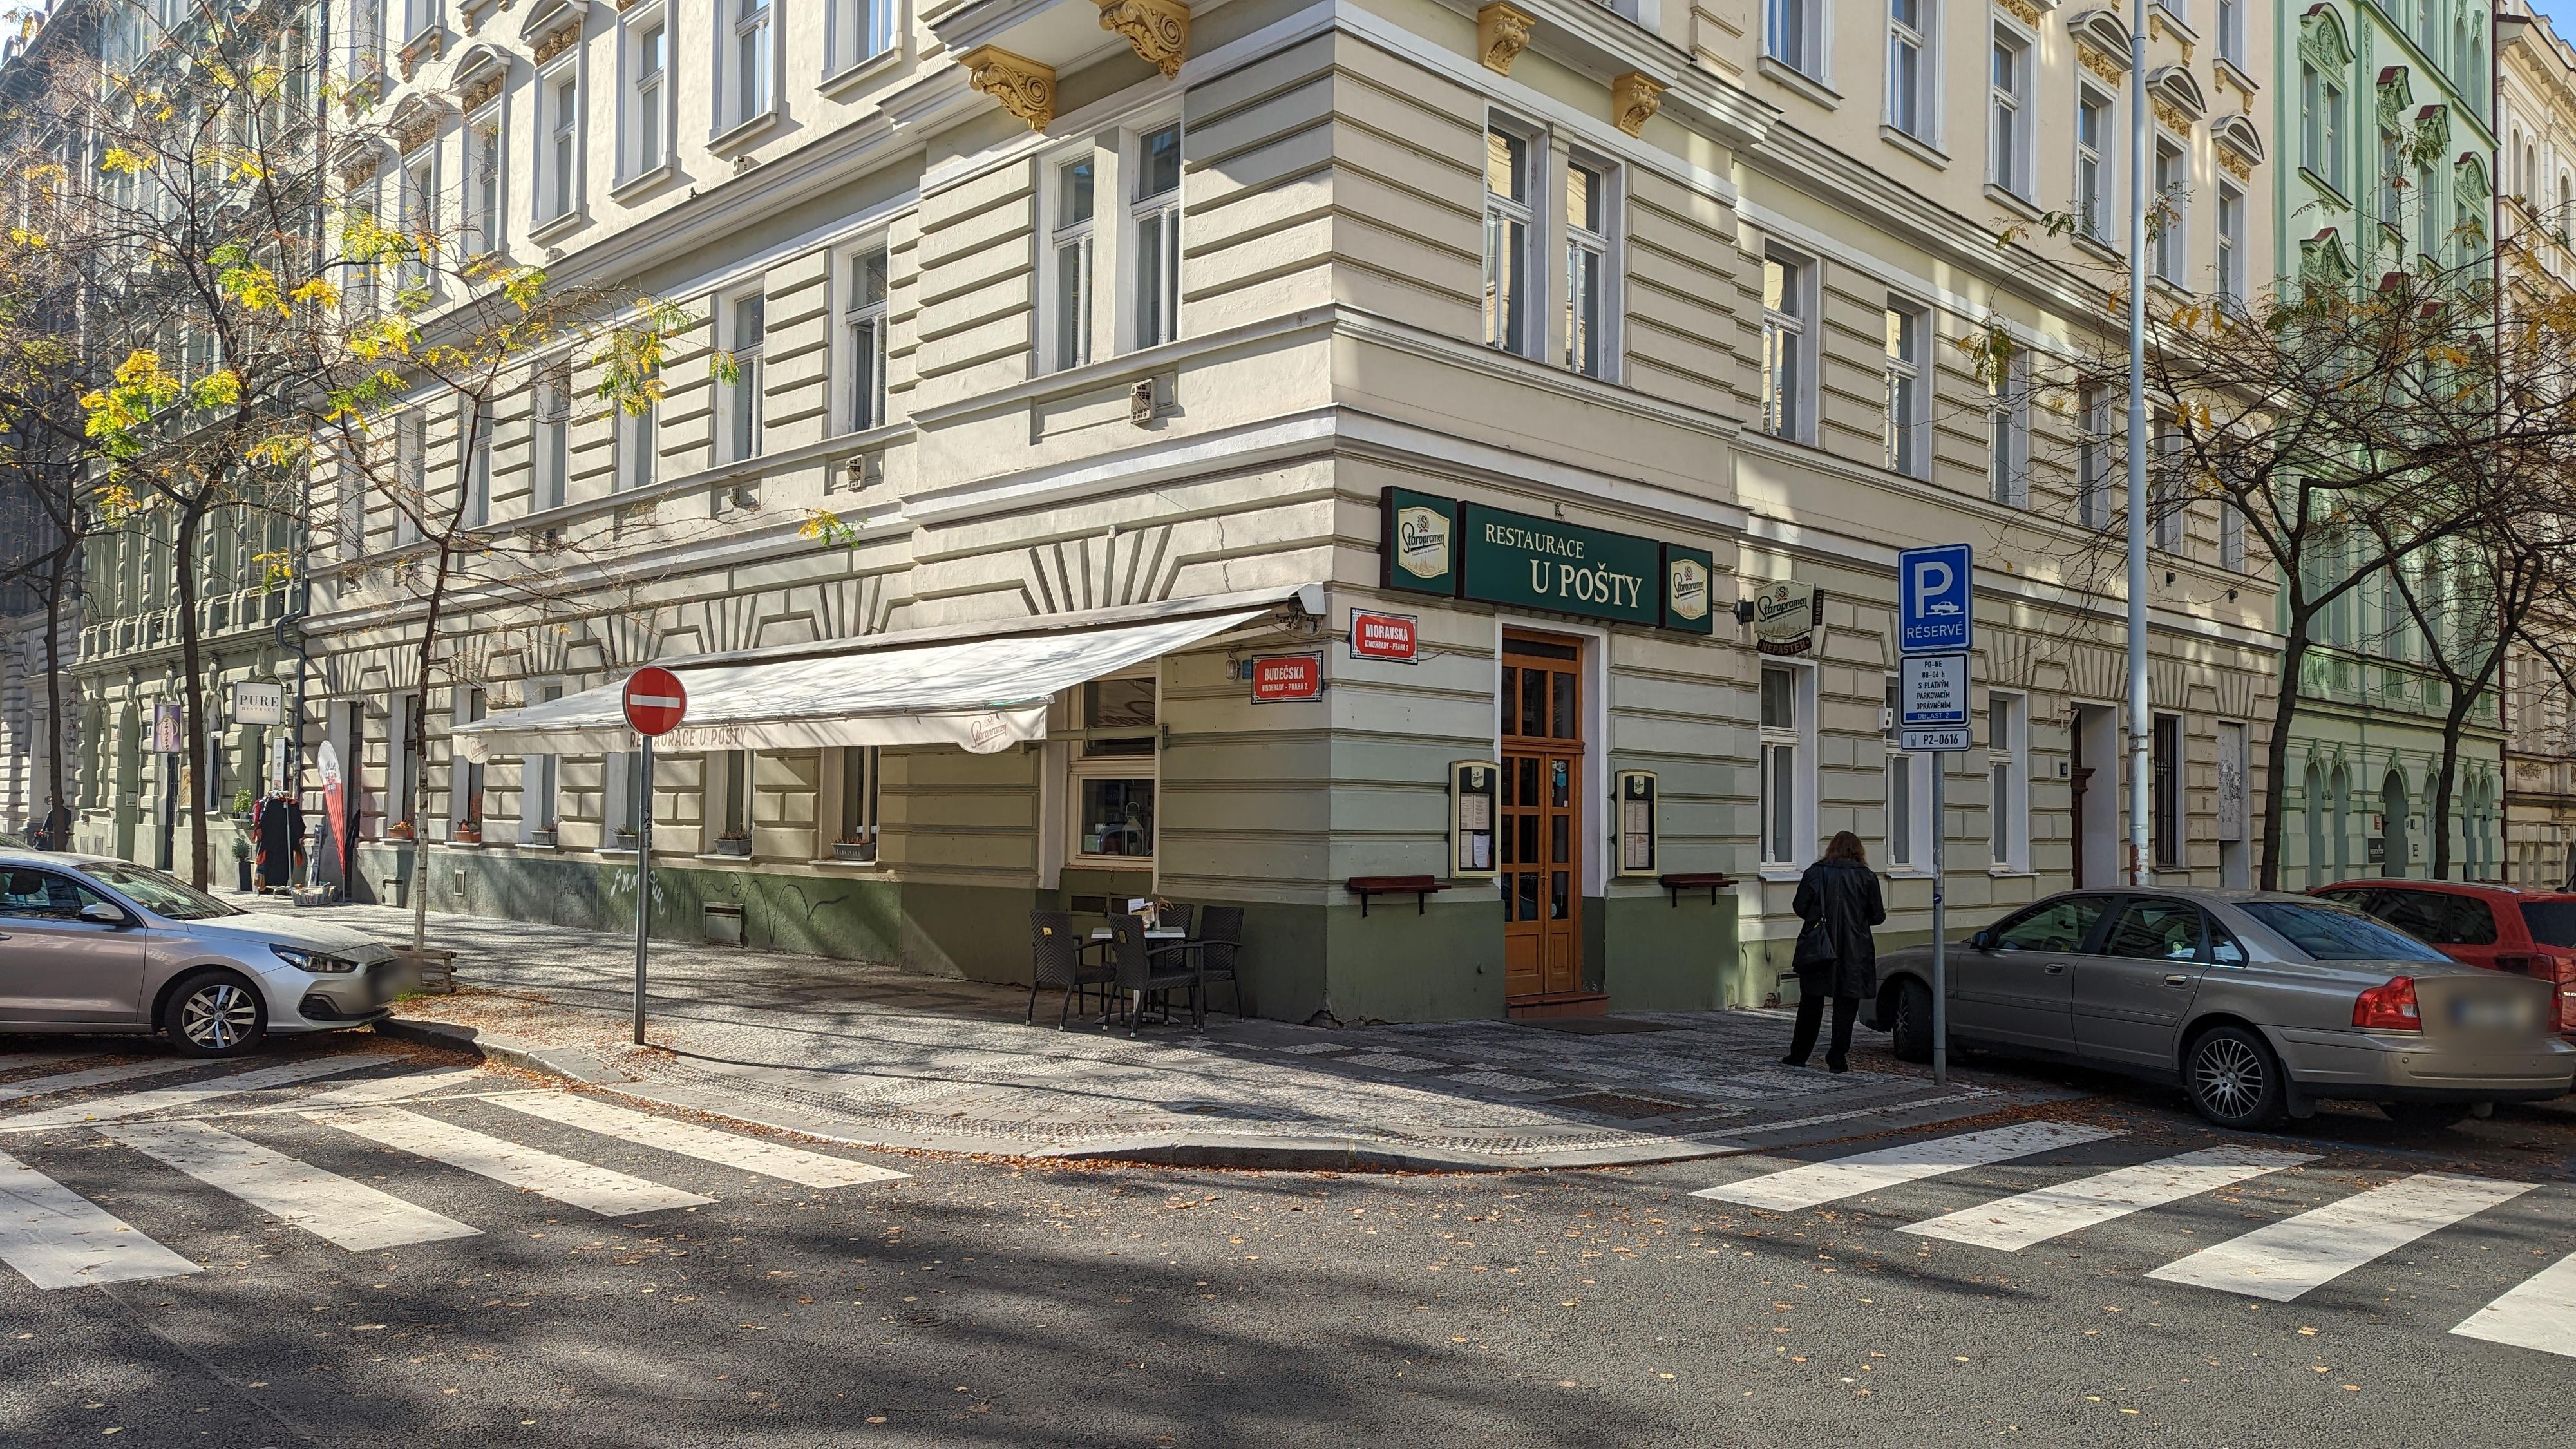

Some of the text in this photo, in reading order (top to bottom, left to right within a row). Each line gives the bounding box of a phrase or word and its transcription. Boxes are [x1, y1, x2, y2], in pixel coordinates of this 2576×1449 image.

[1402, 522, 1446, 553] Staropramen
[1485, 523, 1584, 559] RESTAURACE
[1530, 558, 1643, 609] U POŠTY
[1673, 573, 1705, 598] Staropramen
[1915, 561, 1953, 618] P
[1757, 596, 1808, 622] Staropramen
[1365, 624, 1408, 642] MORAVSKÁ
[1907, 621, 1963, 639] RÉSERVÉ
[1365, 640, 1389, 649] VINOHRADY
[1392, 643, 1405, 651] PRAHA
[1761, 639, 1806, 654] NEPASTER
[1265, 664, 1304, 681] BUDEČSKÁ
[1262, 683, 1284, 692] VINOHRADY
[1289, 683, 1303, 691] PRAHA
[1924, 679, 1949, 688] PLATNÝM
[240, 694, 279, 707] PURE
[1917, 690, 1950, 699] PARKOVACÍM
[1916, 700, 1951, 710] OPRÁVNĚNÍM
[630, 728, 695, 748] REAURACE
[699, 729, 706, 746] U
[971, 721, 1007, 748] Staropramen
[1923, 734, 1958, 745] P2-0616
